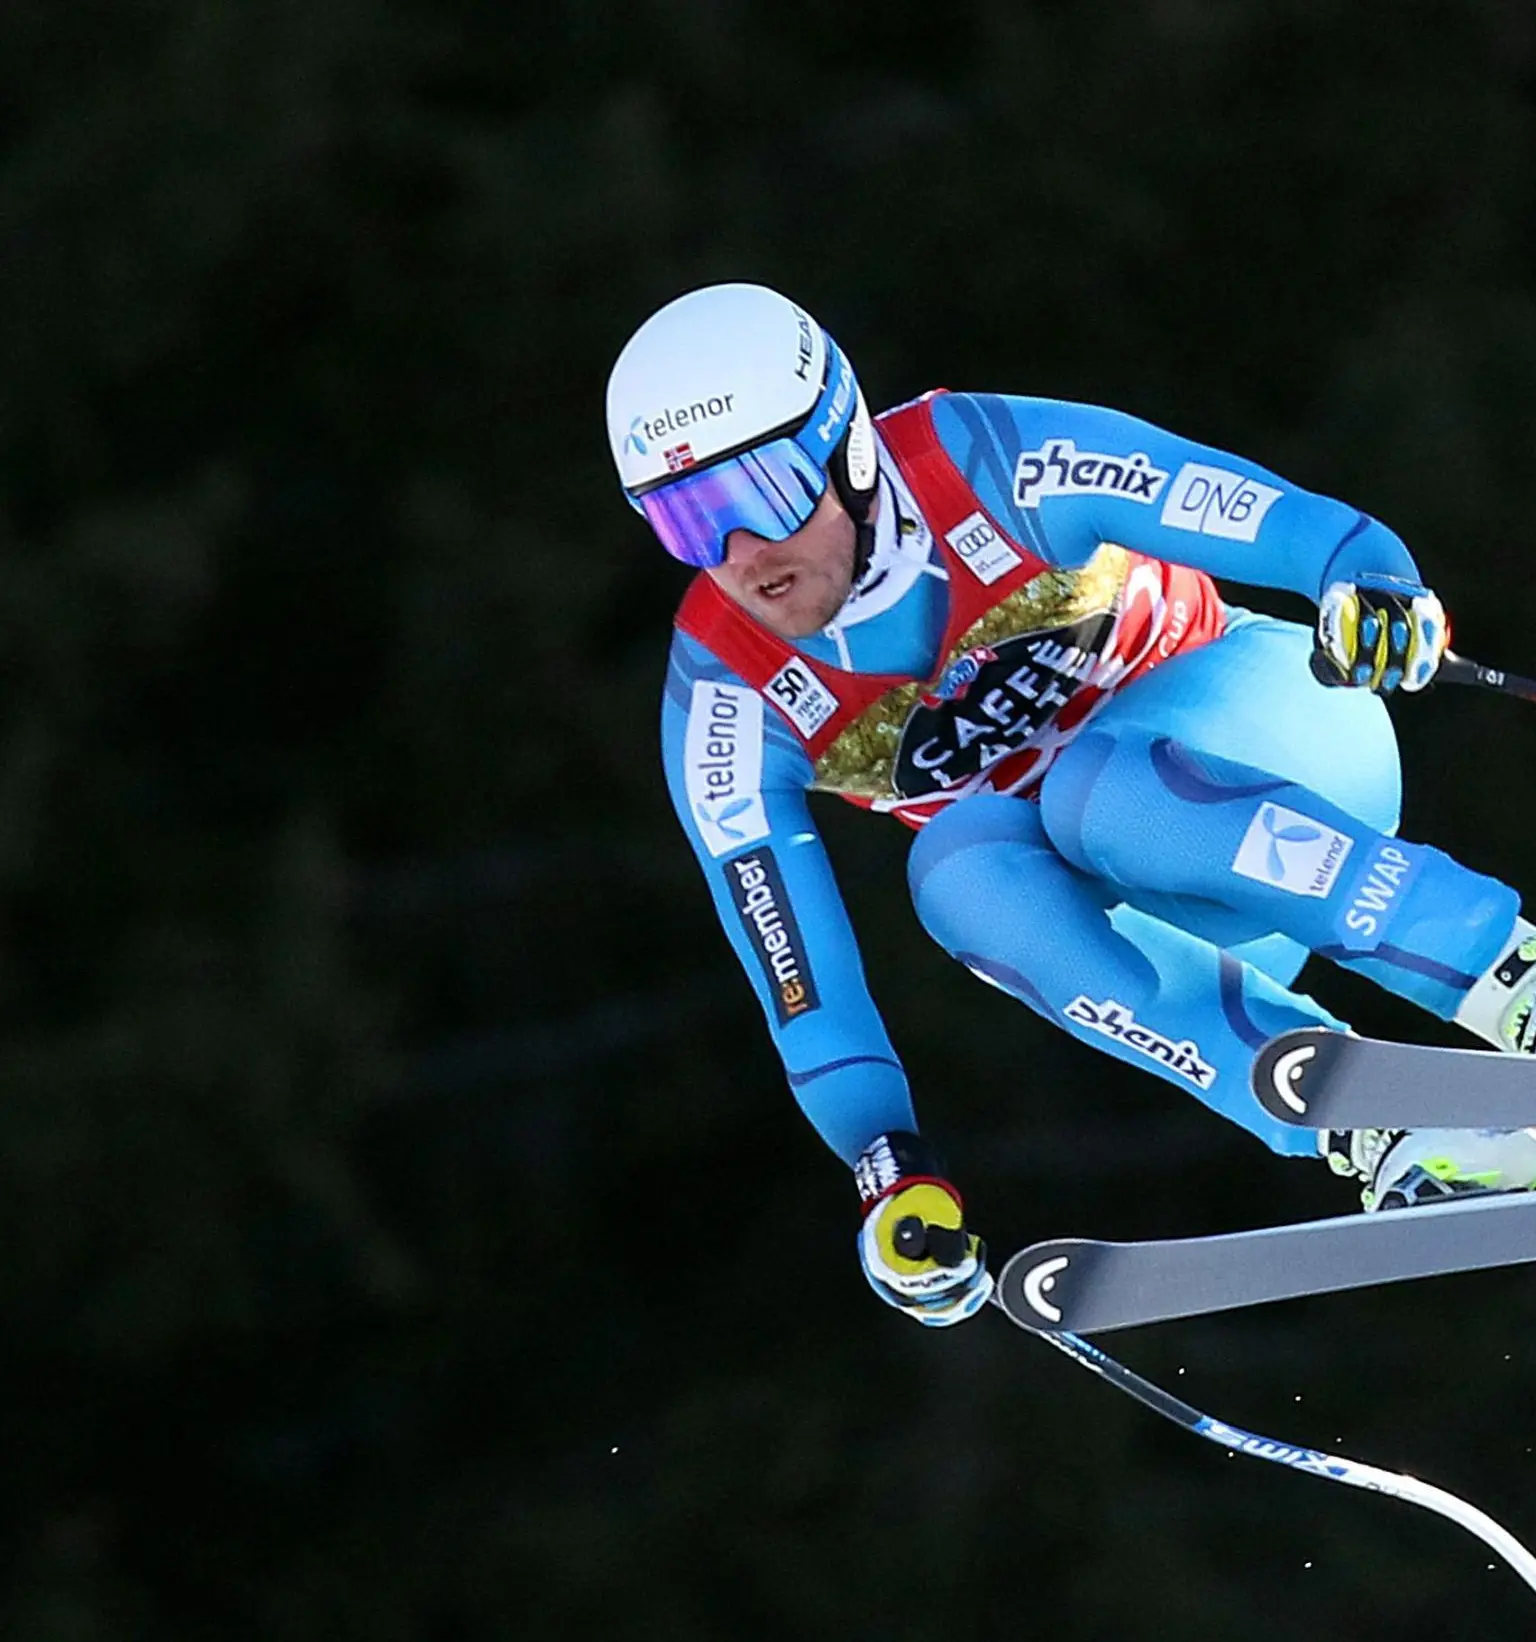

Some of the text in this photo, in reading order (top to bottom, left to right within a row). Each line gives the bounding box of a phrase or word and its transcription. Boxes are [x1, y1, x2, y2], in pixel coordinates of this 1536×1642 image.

[643, 394, 735, 441] telenor
[1018, 445, 1163, 500] phenix
[1181, 477, 1257, 531] DNB
[1159, 600, 1189, 658] CUP
[771, 667, 809, 706] 50
[698, 687, 739, 800] telenor
[1310, 835, 1346, 893] telenor
[1345, 846, 1411, 937] SWAP
[1068, 1001, 1210, 1084] phenix
